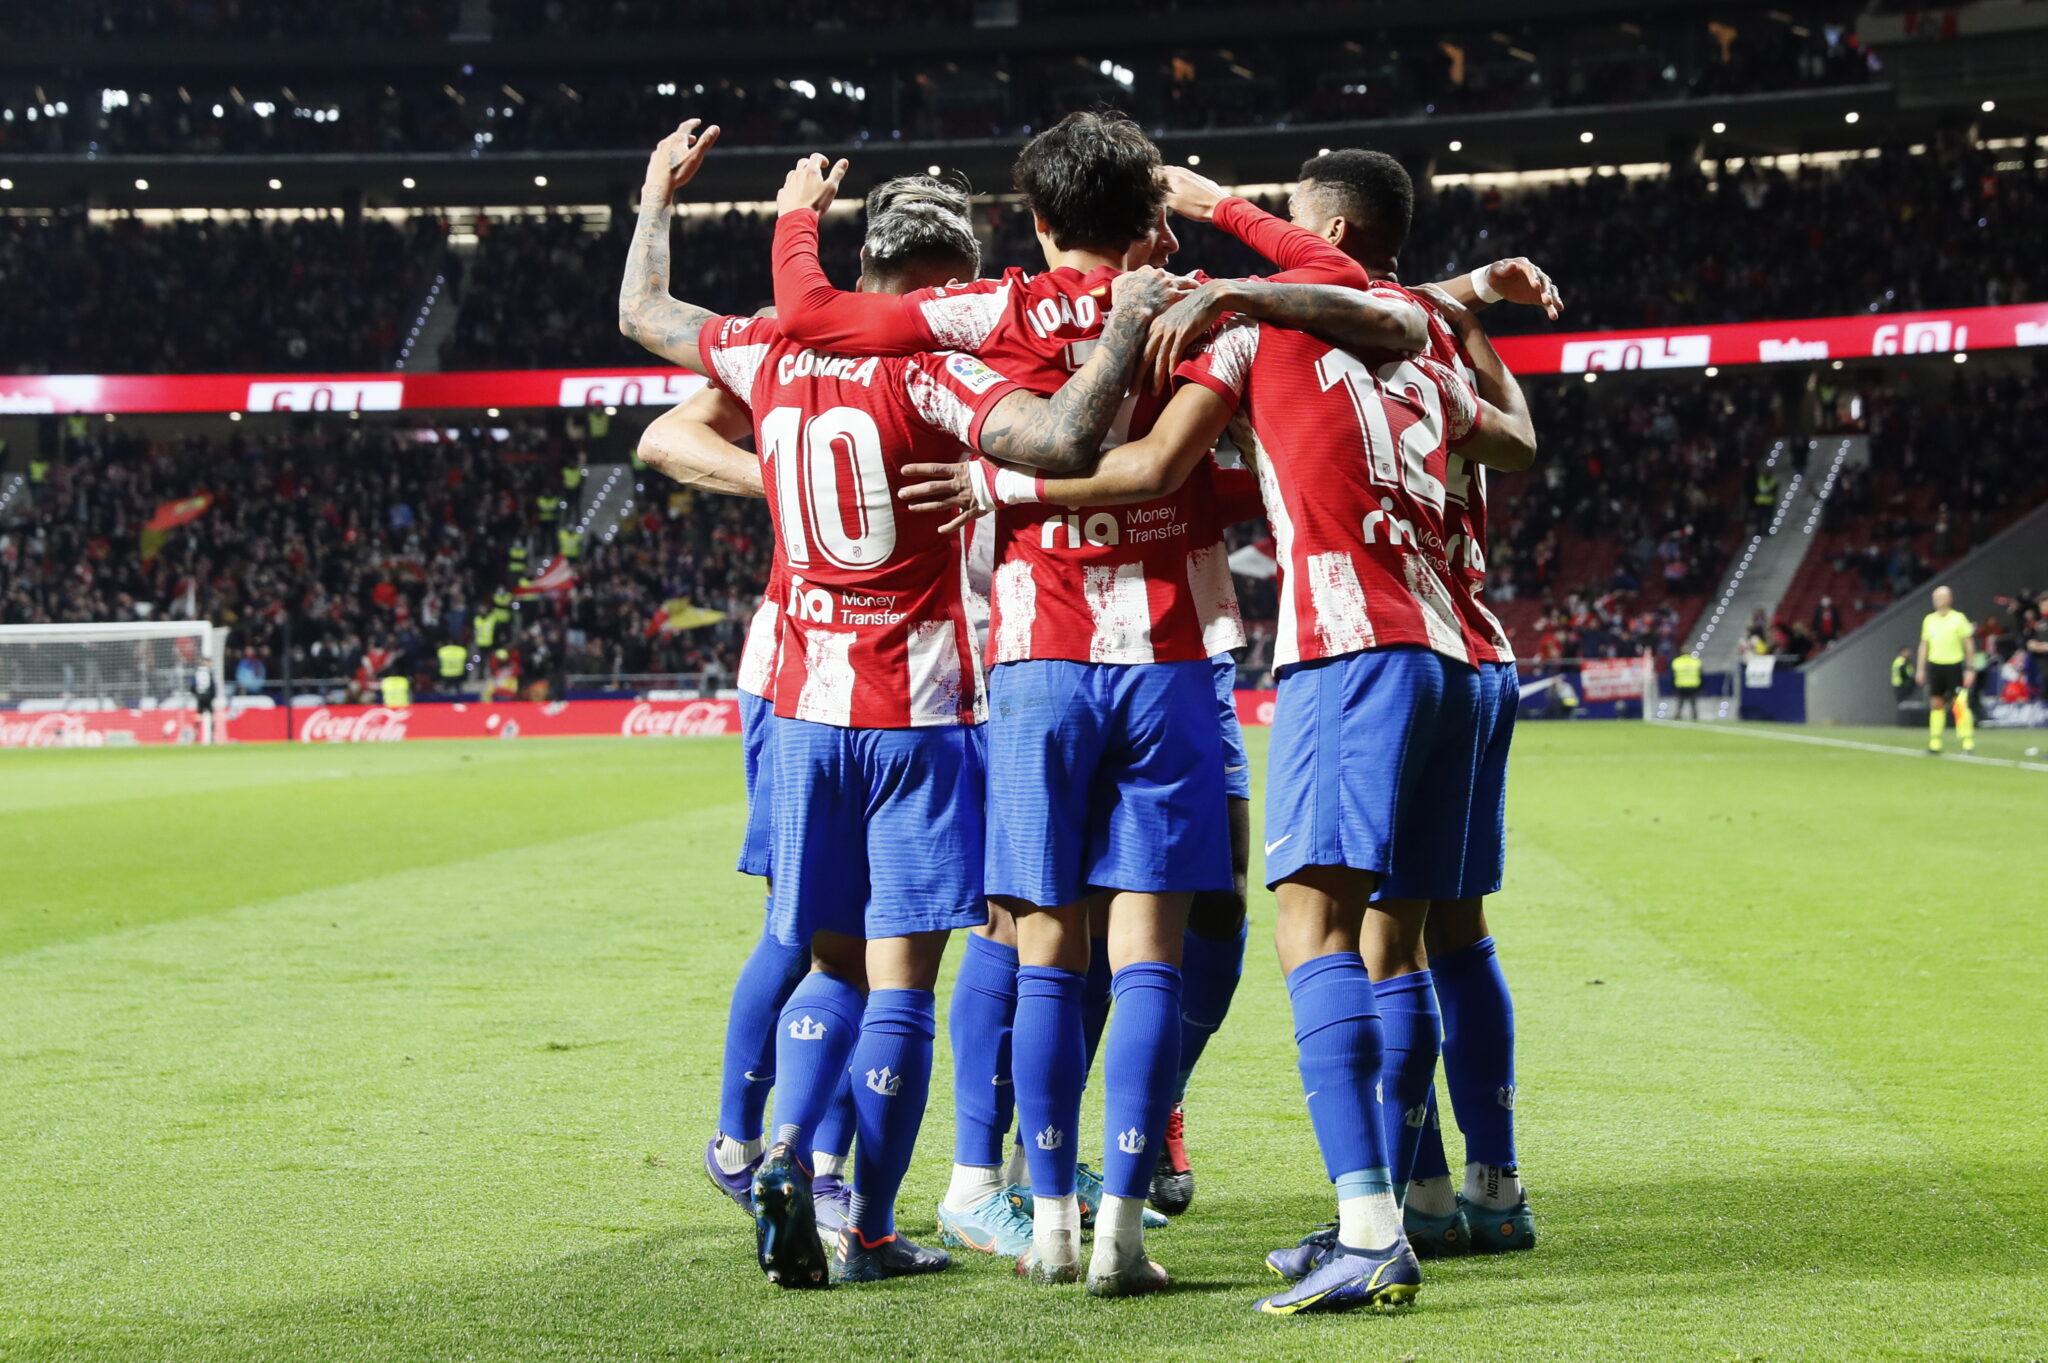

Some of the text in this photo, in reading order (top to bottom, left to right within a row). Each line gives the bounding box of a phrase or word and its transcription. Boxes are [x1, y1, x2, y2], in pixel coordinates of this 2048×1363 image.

[1313, 347, 1447, 521] 12
[760, 405, 897, 571] 10
[1040, 504, 1120, 549] ria
[1126, 505, 1177, 525] Money
[1126, 520, 1189, 544] Transfer
[842, 591, 896, 610] Money
[840, 609, 908, 626] Transfer
